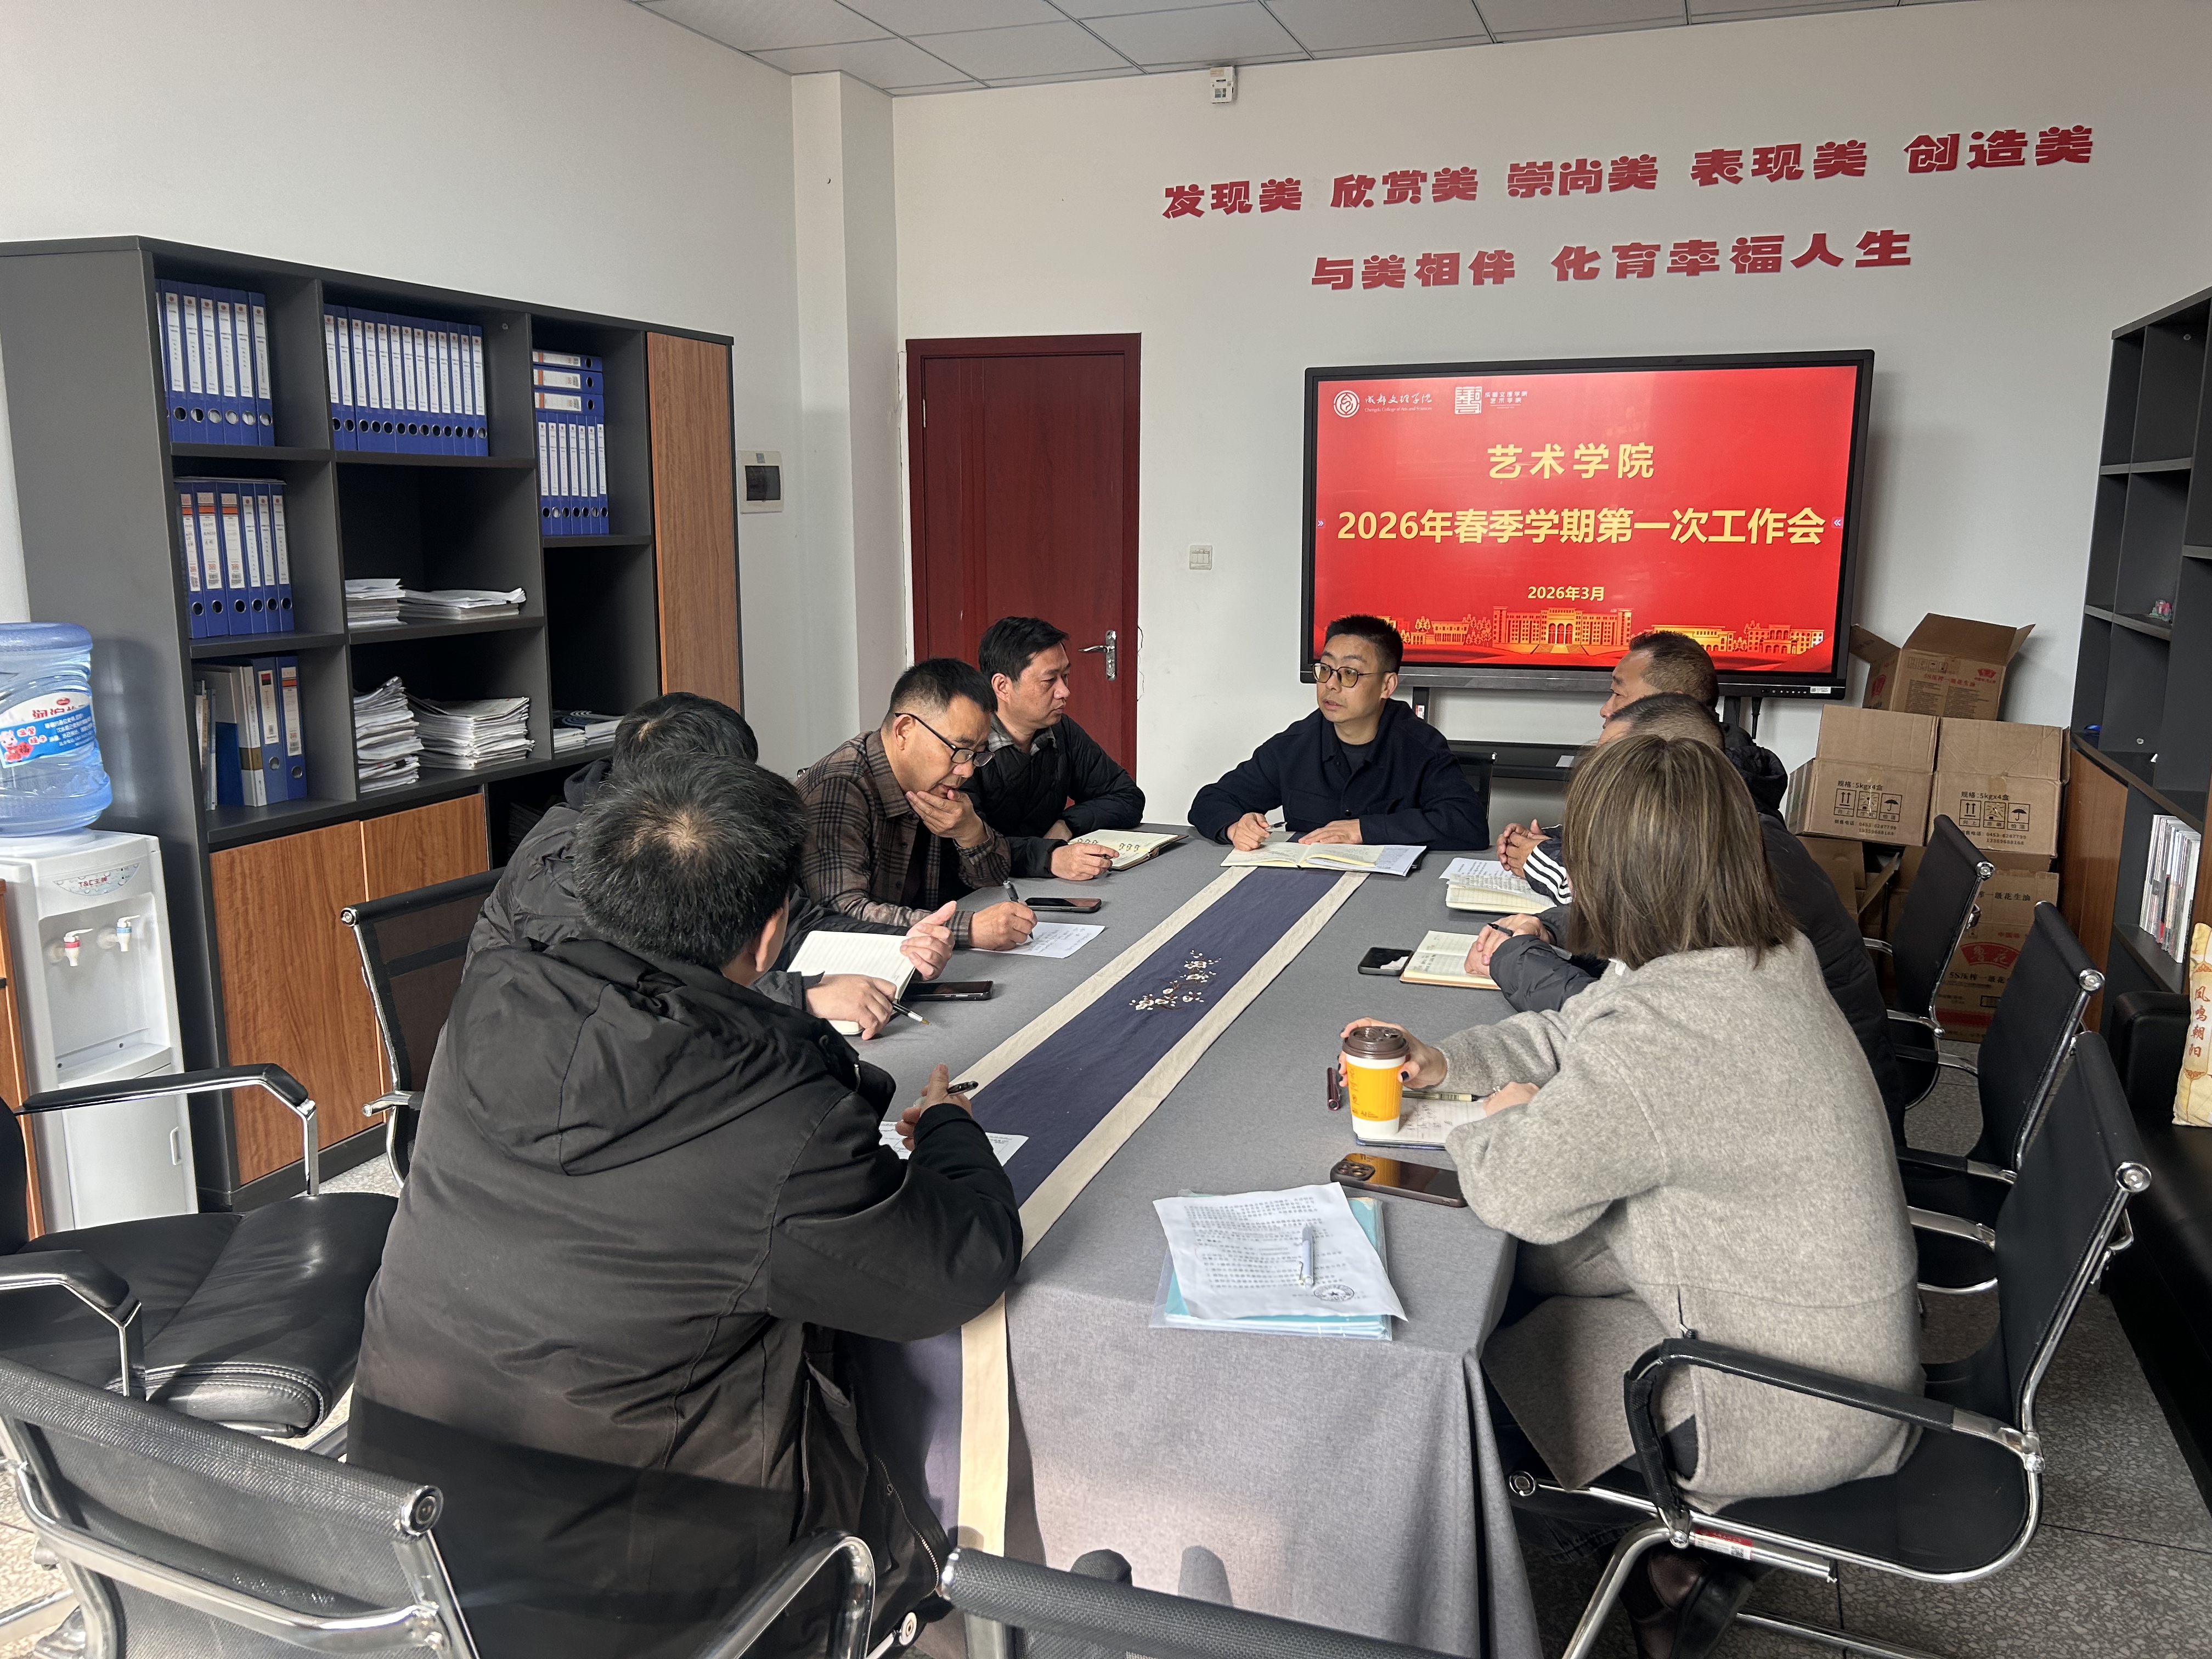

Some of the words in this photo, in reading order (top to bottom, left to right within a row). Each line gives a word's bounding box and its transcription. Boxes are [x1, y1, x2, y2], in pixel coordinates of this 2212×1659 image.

[1163, 177, 1302, 219] 发现美
[1330, 166, 1478, 208] 欣赏美
[1508, 154, 1658, 198] 崇尚美
[1691, 140, 1867, 187] 表现美
[1904, 125, 2093, 173] 创造美
[1312, 250, 1515, 290] 与美相伴
[1551, 229, 1910, 281] 化育幸福人生
[1364, 392, 1432, 405] 成都文理学院
[1487, 442, 1654, 484] 艺术学院
[1337, 507, 1826, 545] 2026年春季学期第一次工作会
[1527, 585, 1604, 601] 2026年3月
[1949, 972, 2010, 984] 5S压榨一级花
[2188, 985, 2211, 1058] 凤鸣朝阳
